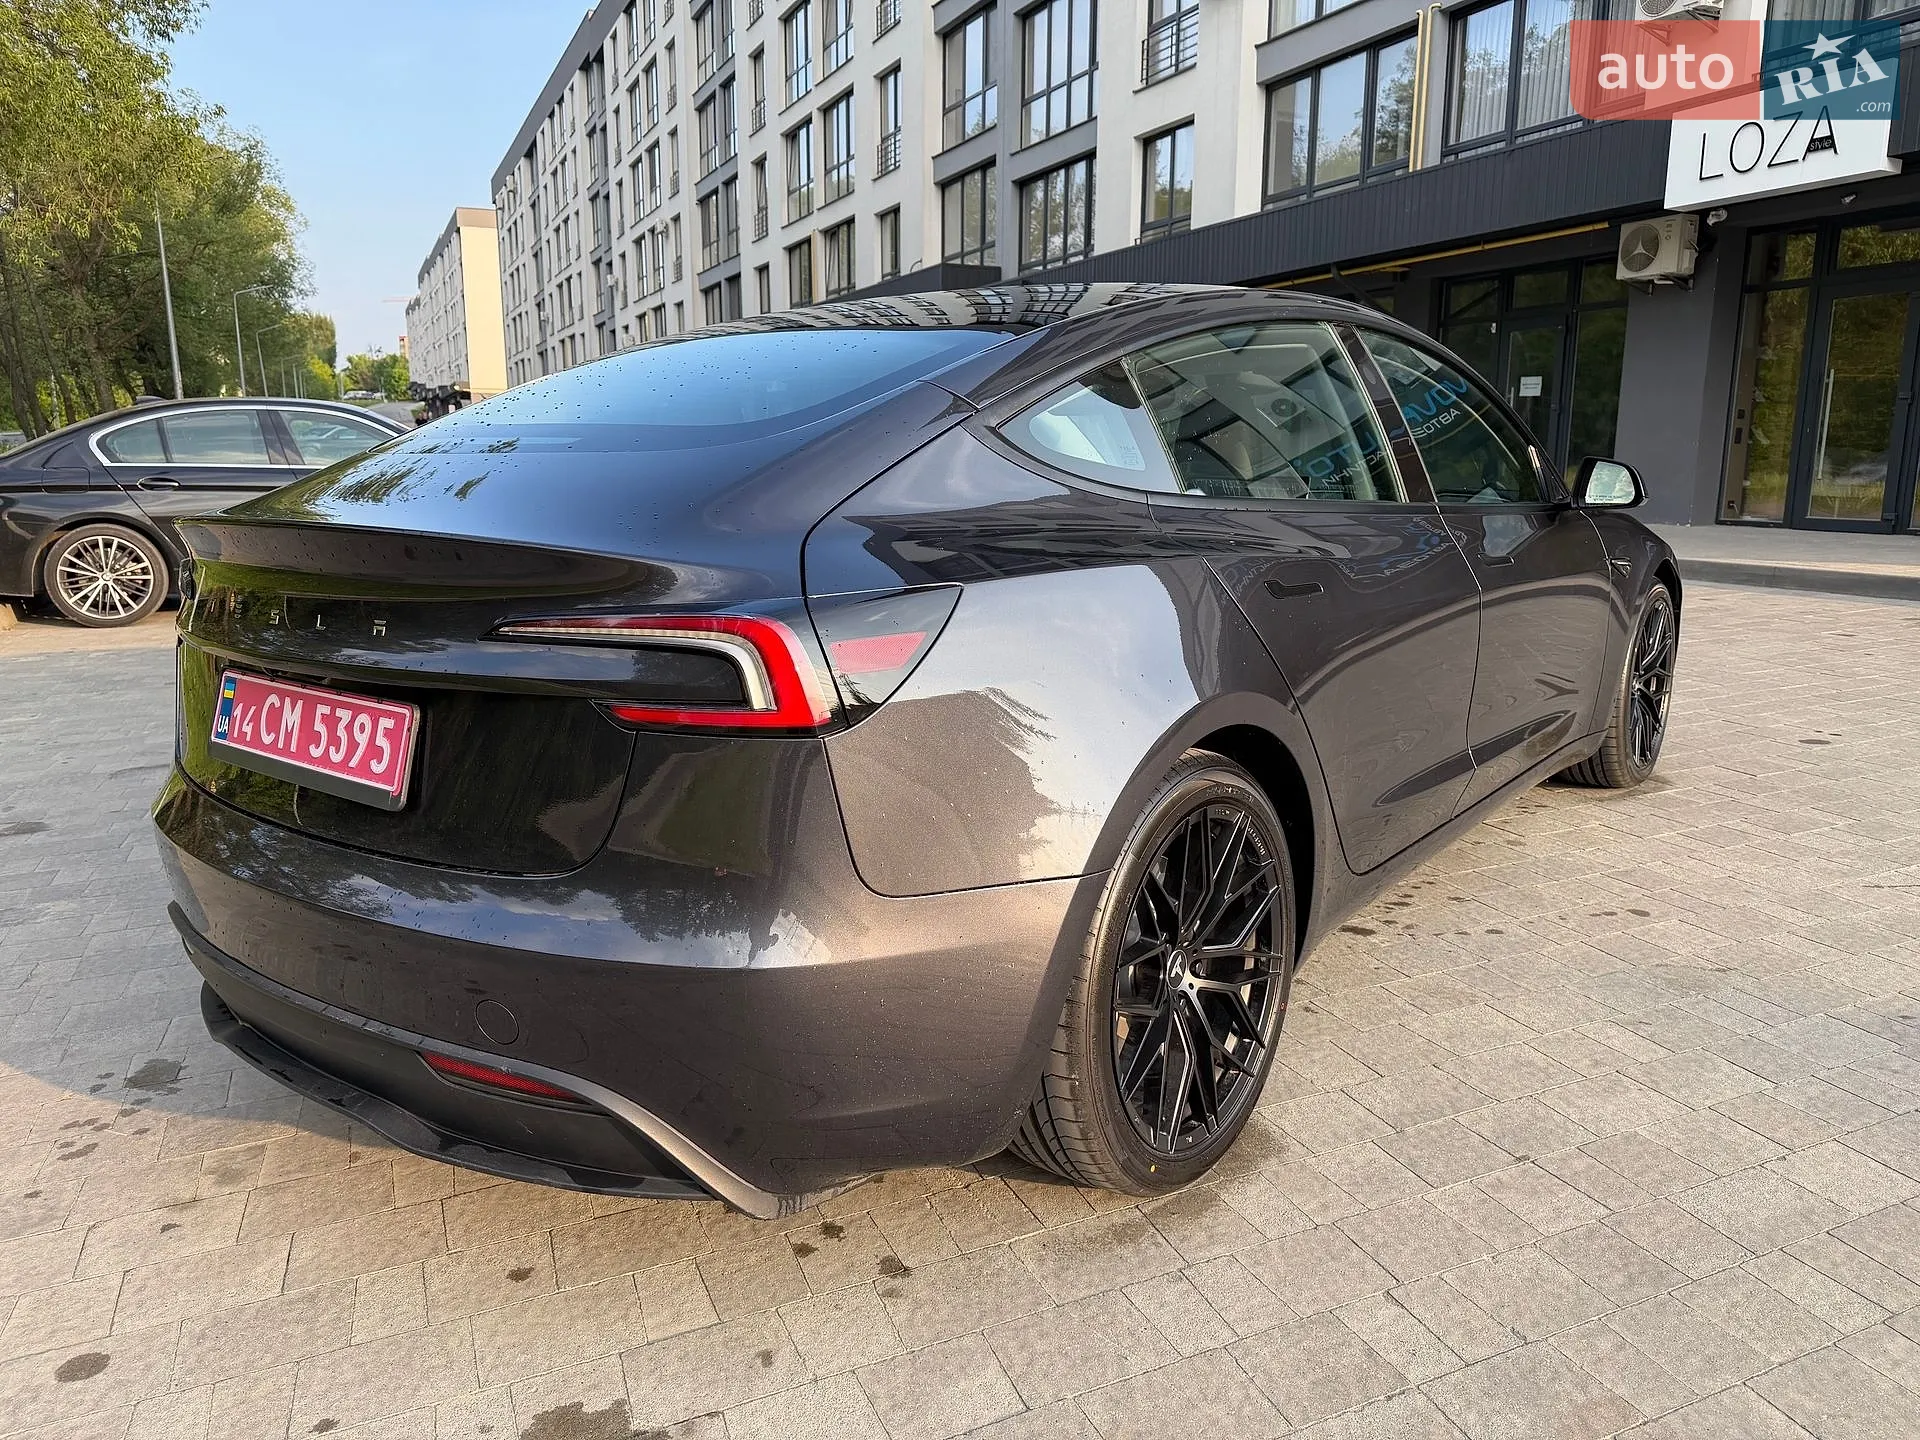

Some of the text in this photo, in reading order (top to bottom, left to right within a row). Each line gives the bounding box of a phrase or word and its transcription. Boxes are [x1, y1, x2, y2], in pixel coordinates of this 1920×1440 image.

[1699, 105, 1839, 181] LOZA
[217, 714, 229, 734] UA
[233, 693, 395, 775] 14 CM 5395
